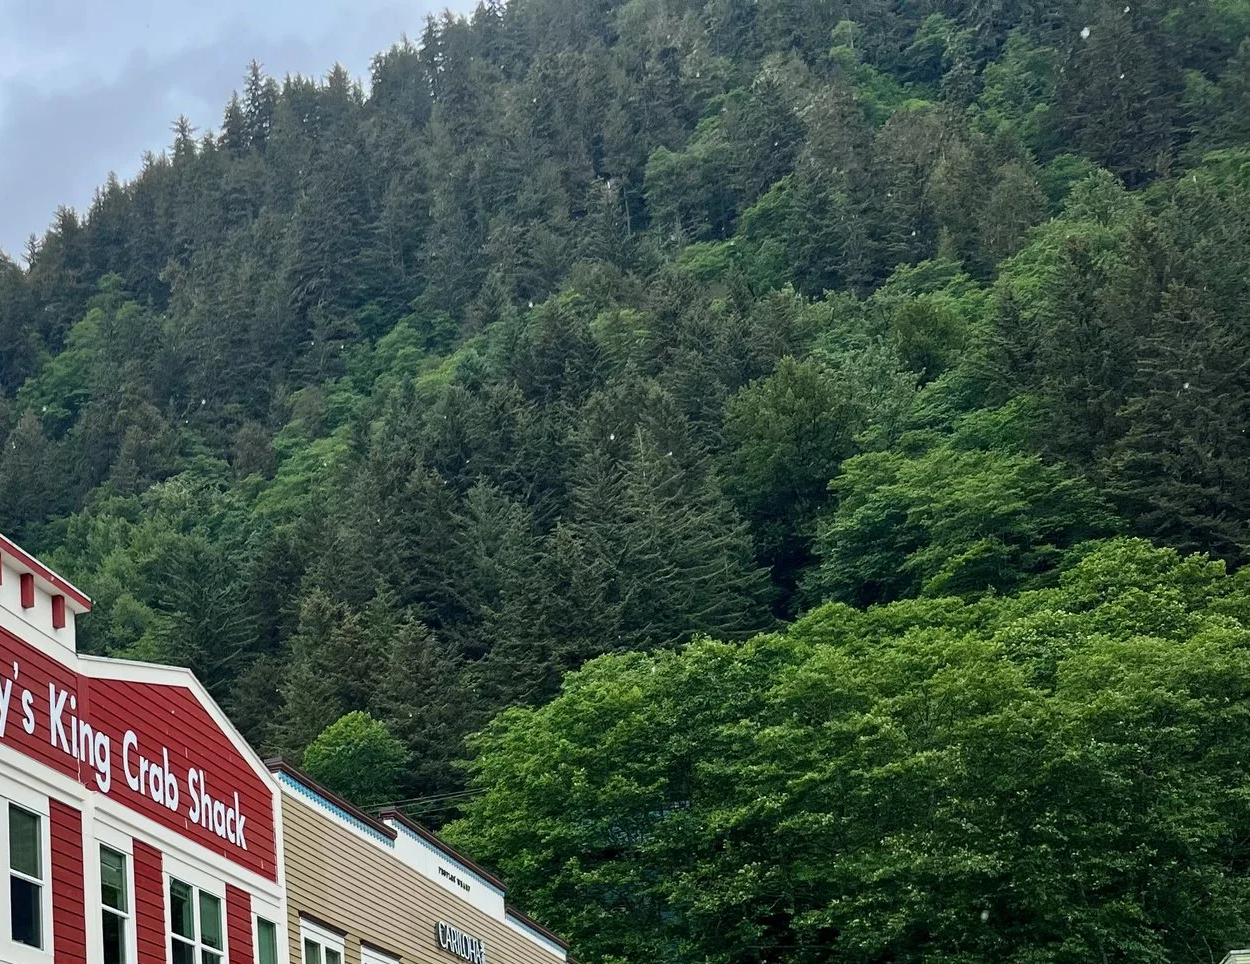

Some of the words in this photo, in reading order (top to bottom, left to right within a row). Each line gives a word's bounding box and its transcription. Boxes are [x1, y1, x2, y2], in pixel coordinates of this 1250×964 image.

[49, 683, 111, 793] King
[123, 729, 179, 812] Crab
[188, 767, 247, 851] Shack
